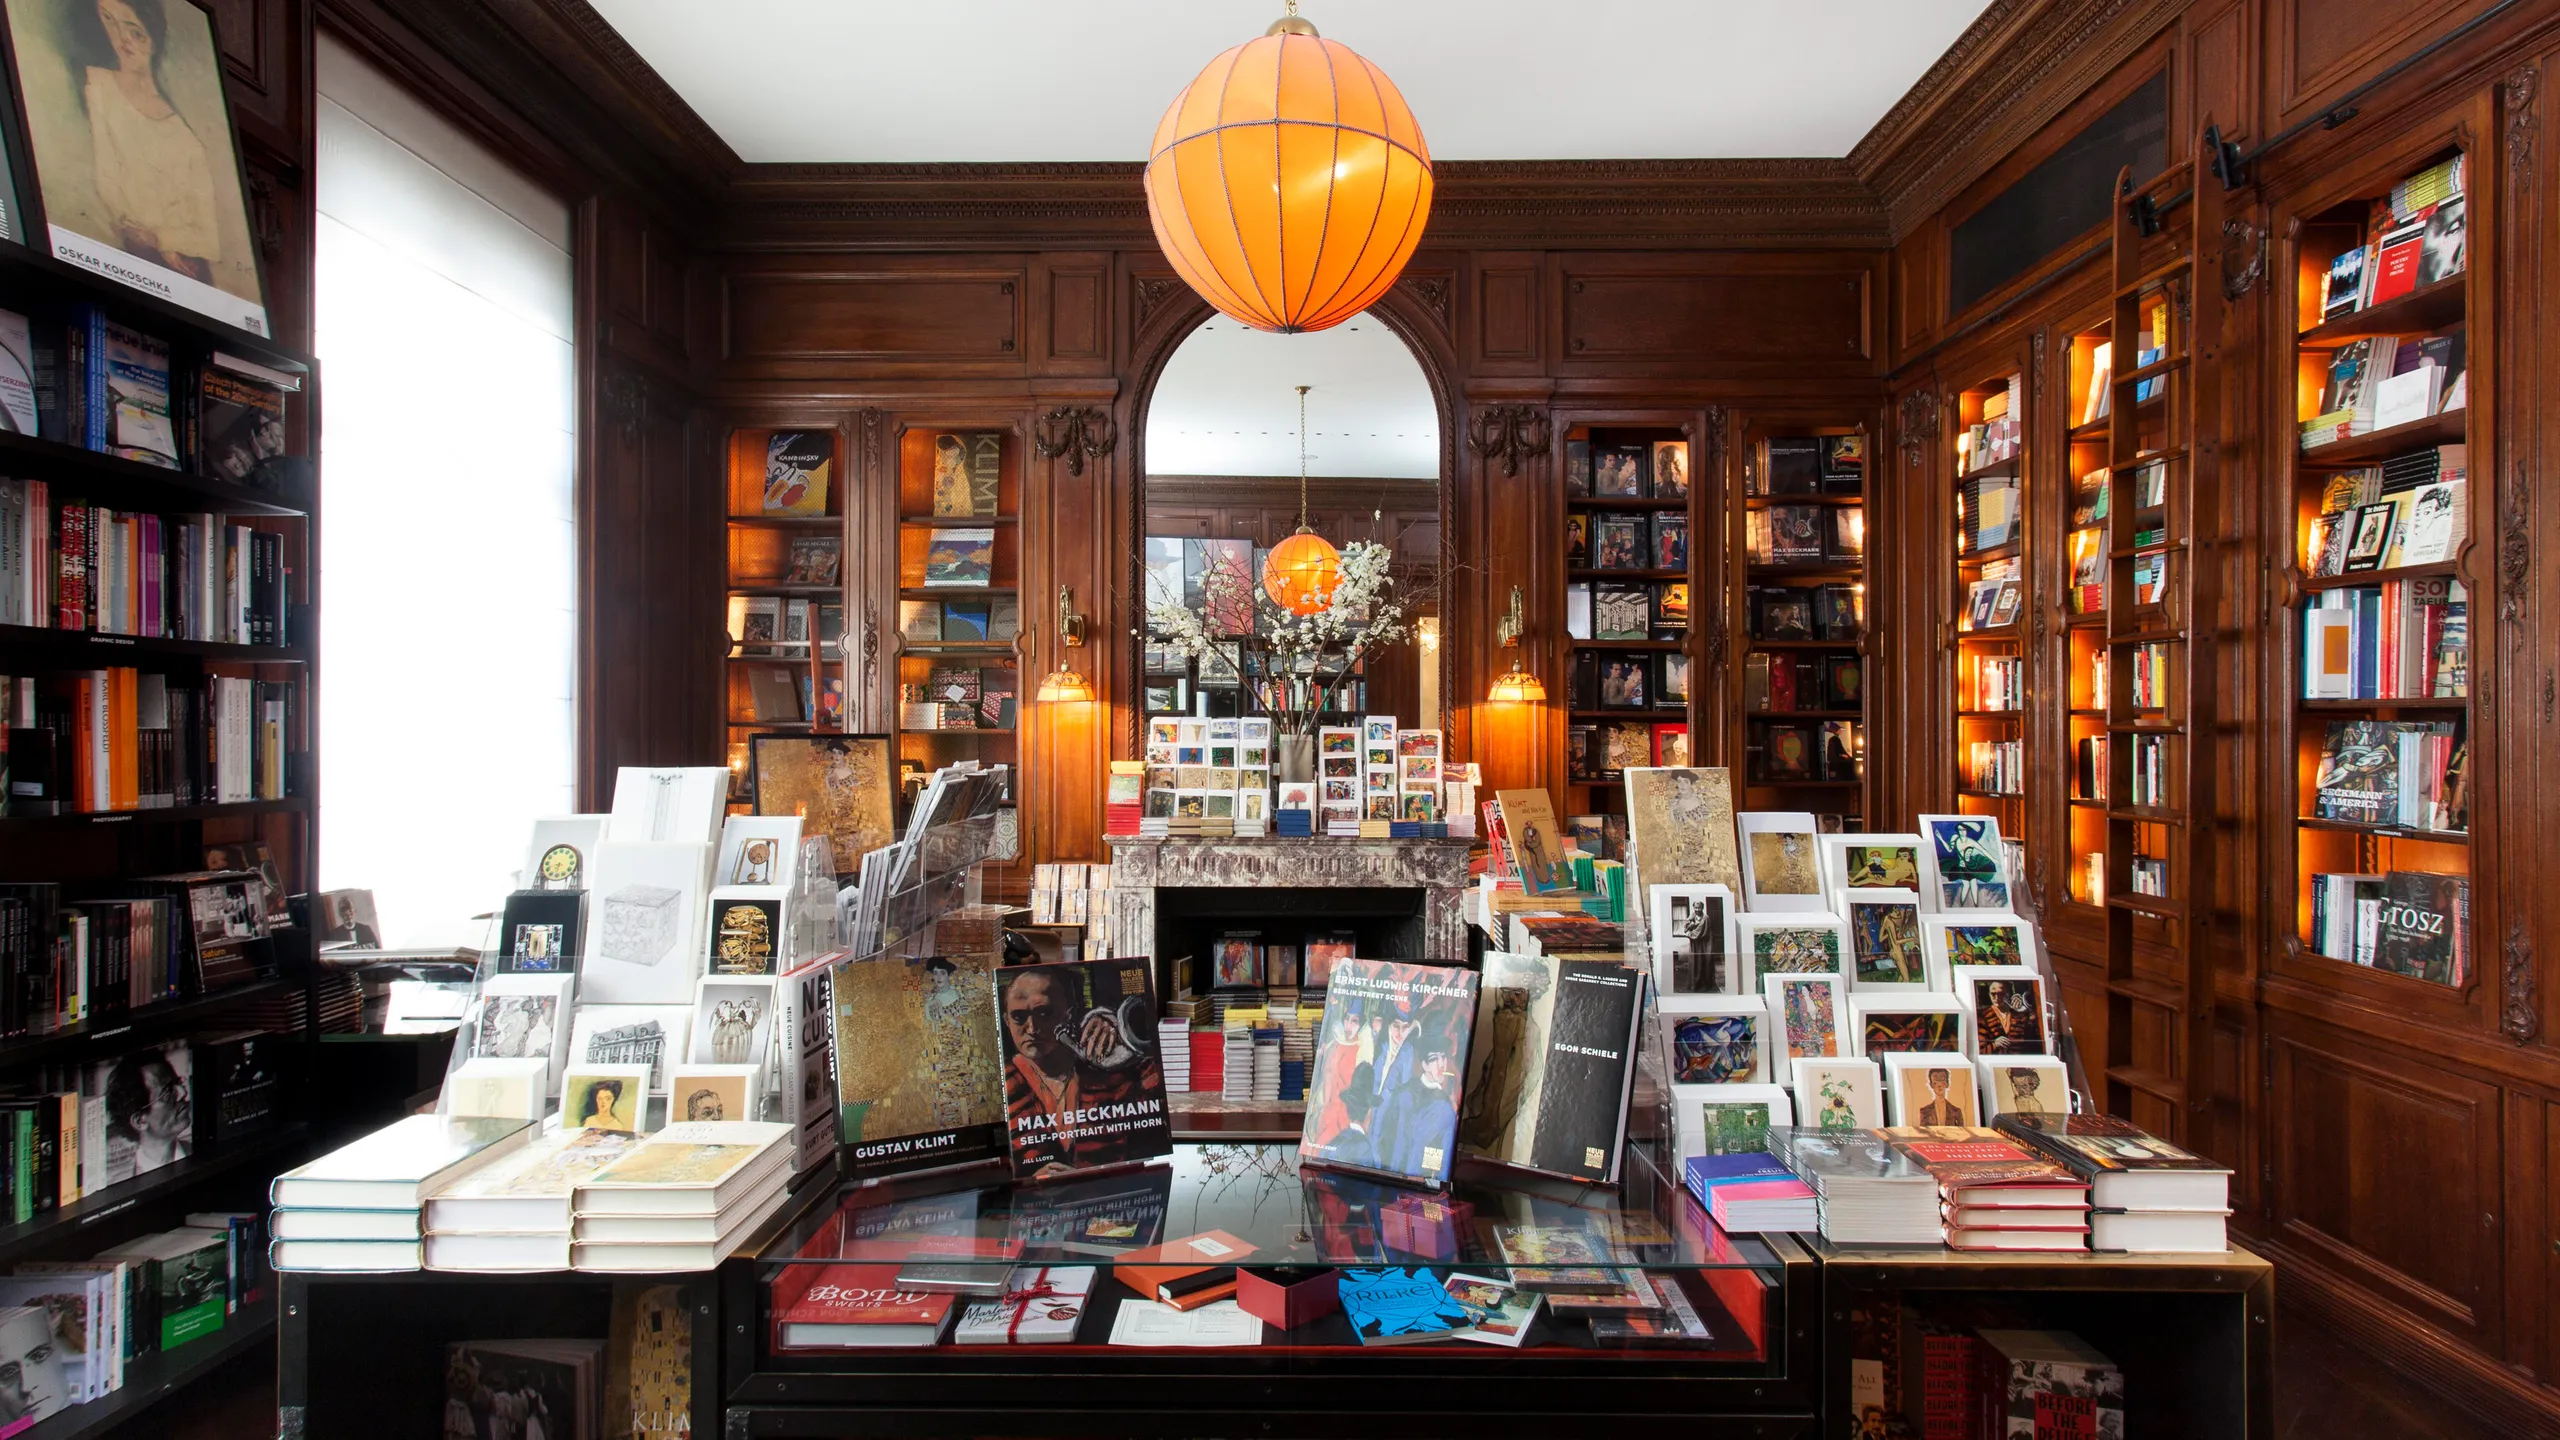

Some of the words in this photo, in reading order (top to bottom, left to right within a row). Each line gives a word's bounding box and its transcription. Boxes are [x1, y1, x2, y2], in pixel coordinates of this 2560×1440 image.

[58, 245, 101, 269] OSKAR
[103, 261, 172, 294] KOKOSCHKA
[778, 454, 819, 462] KANDINSKY
[974, 433, 1000, 515] KLIMT
[2413, 581, 2448, 595] SO
[101, 678, 109, 702] KARL
[101, 703, 109, 754] BLOSSFELDT
[2319, 797, 2328, 805] &
[2330, 798, 2379, 809] AMERICA
[2320, 788, 2383, 800] BECKMANN
[267, 912, 290, 923] MANN
[1120, 968, 1143, 977] NEUE
[802, 974, 826, 1018] NE
[1333, 988, 1357, 997] BERLIN
[1358, 991, 1384, 999] STREET
[1385, 994, 1409, 1002] SCENE
[1334, 975, 1368, 986] ERNST
[1370, 979, 1410, 991] LUDWIG
[1412, 984, 1469, 999] KIRCHNER
[824, 980, 833, 1038] GUSTAV
[802, 1019, 826, 1048] CUI
[828, 1040, 836, 1081] KLIMT
[1554, 1043, 1579, 1053] EGON
[1580, 1046, 1618, 1060] SCHIELE
[1018, 1112, 1058, 1132] MAX
[1063, 1099, 1160, 1124] BECKMANN
[820, 1124, 834, 1143] GUTE
[1020, 1125, 1105, 1147] SELF-PORTRAIT
[1106, 1121, 1131, 1133] WITH
[1133, 1117, 1163, 1130] HORN
[856, 1140, 911, 1159] GUSTAV
[915, 1134, 957, 1151] KLIMT
[1586, 1146, 1605, 1155] NEUE
[1022, 1157, 1034, 1165] JILL
[1035, 1154, 1055, 1164] LLOYD
[2039, 1151, 2066, 1169] FREUD
[808, 1284, 930, 1306] BODY
[825, 1300, 882, 1308] SWEATS
[968, 1311, 1017, 1328] Dietric
[2037, 1395, 2095, 1416] BEFORE
[2052, 1412, 2080, 1430] THE
